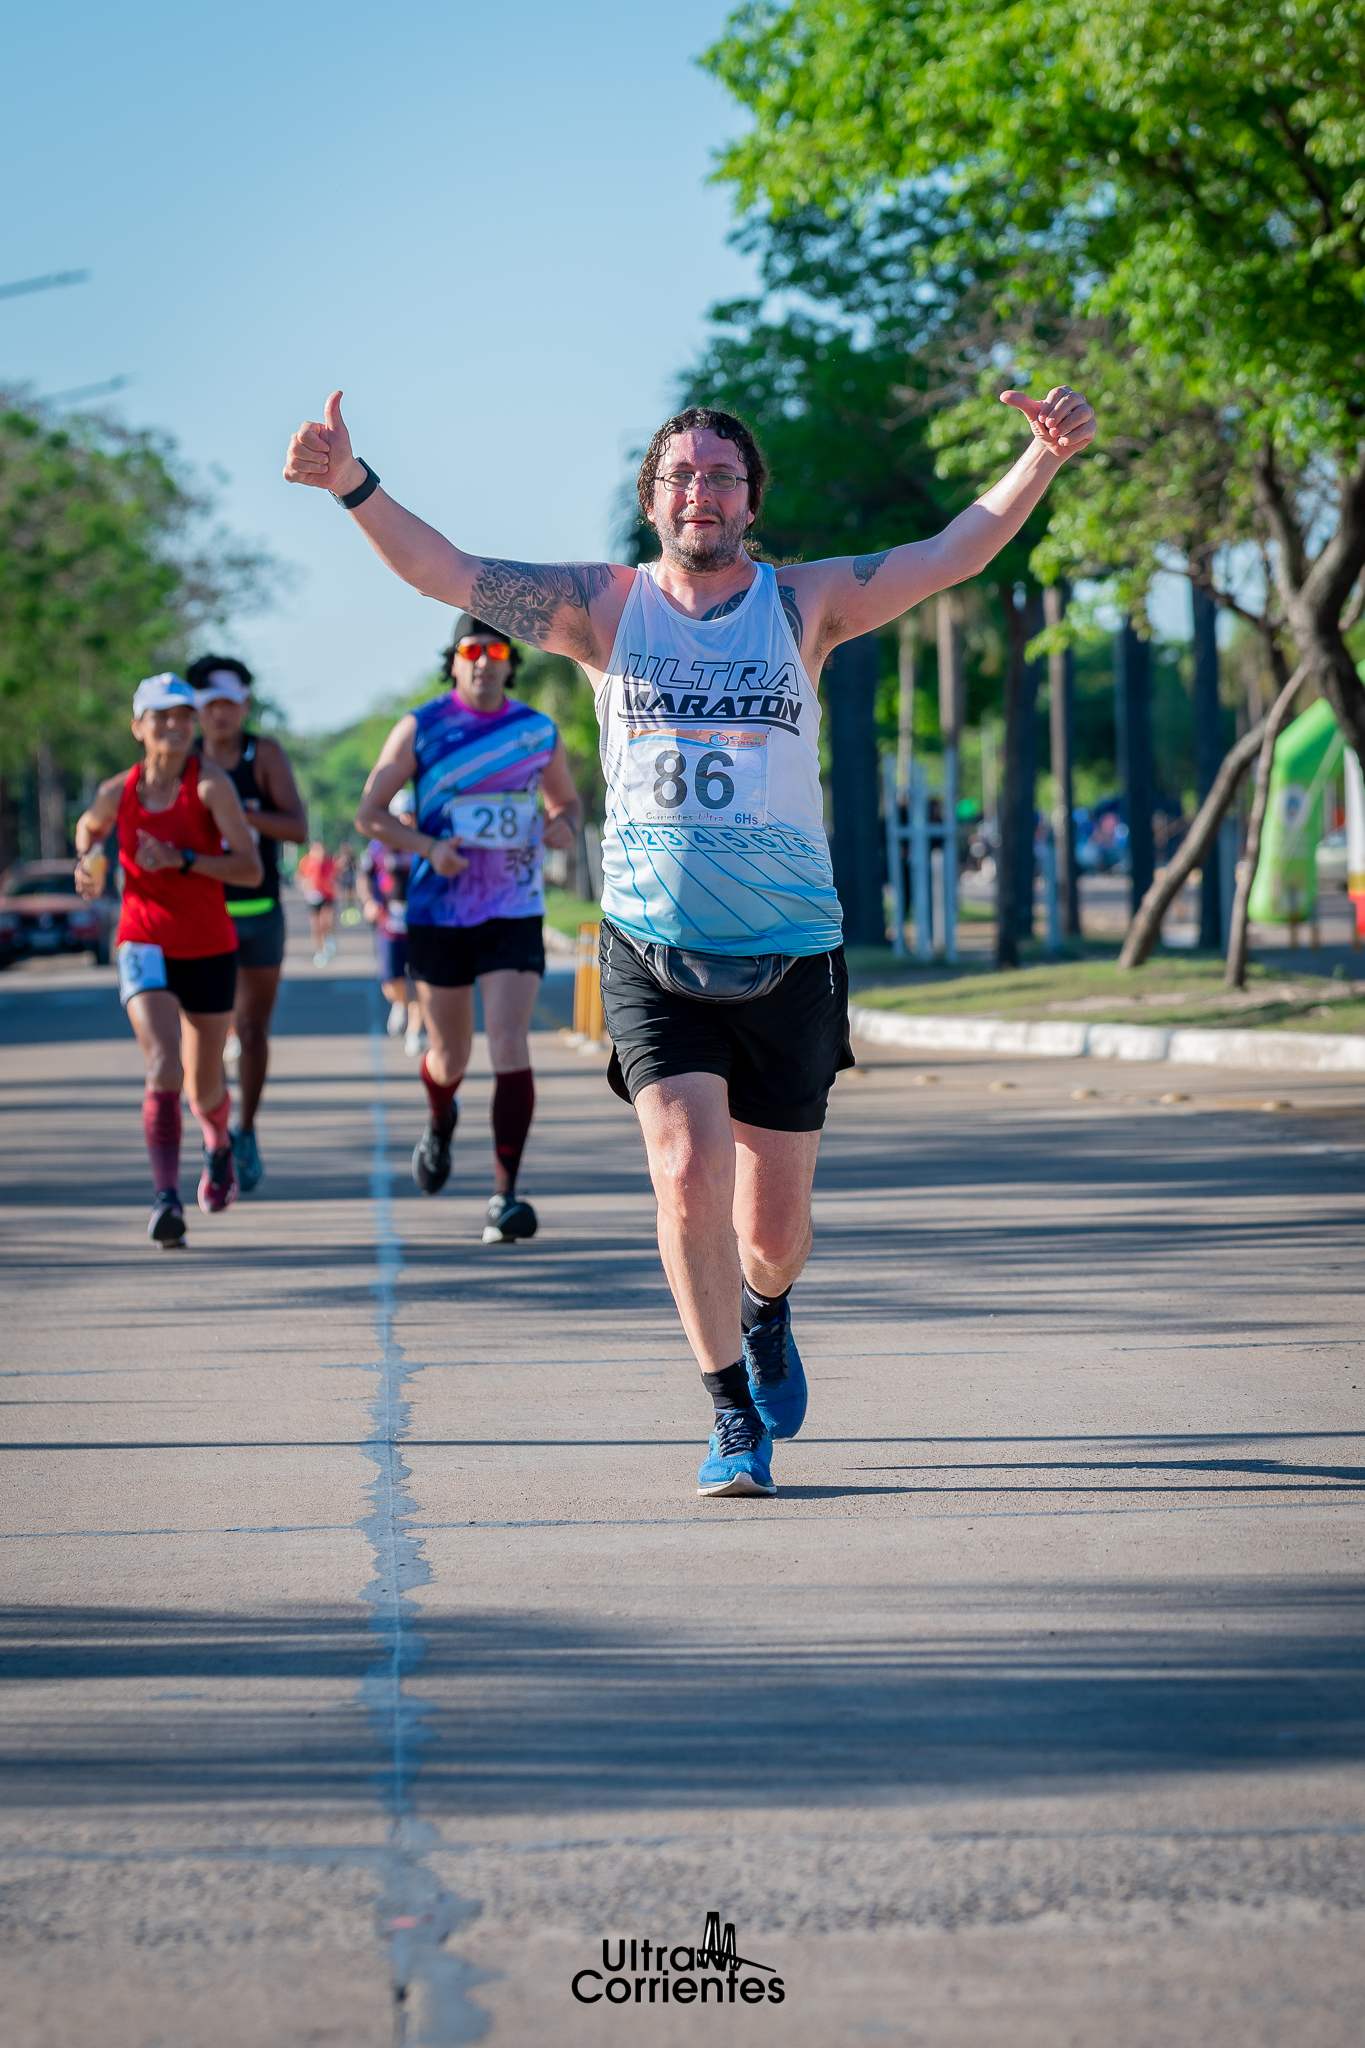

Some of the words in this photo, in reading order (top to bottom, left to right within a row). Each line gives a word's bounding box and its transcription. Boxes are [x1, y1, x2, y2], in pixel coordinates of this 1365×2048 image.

[623, 653, 799, 696] ULTRA
[622, 689, 802, 725] MARATÓN
[653, 750, 734, 810] 86
[473, 807, 517, 838] 28
[646, 811, 693, 821] Corrientes
[698, 812, 724, 822] Ultra
[734, 812, 758, 825] 6Hs
[624, 829, 636, 845] 1
[642, 830, 657, 846] 2
[662, 830, 682, 846] 3
[693, 831, 716, 848] 4
[719, 832, 748, 849] 5
[750, 833, 777, 848] 6
[772, 833, 793, 851] 7
